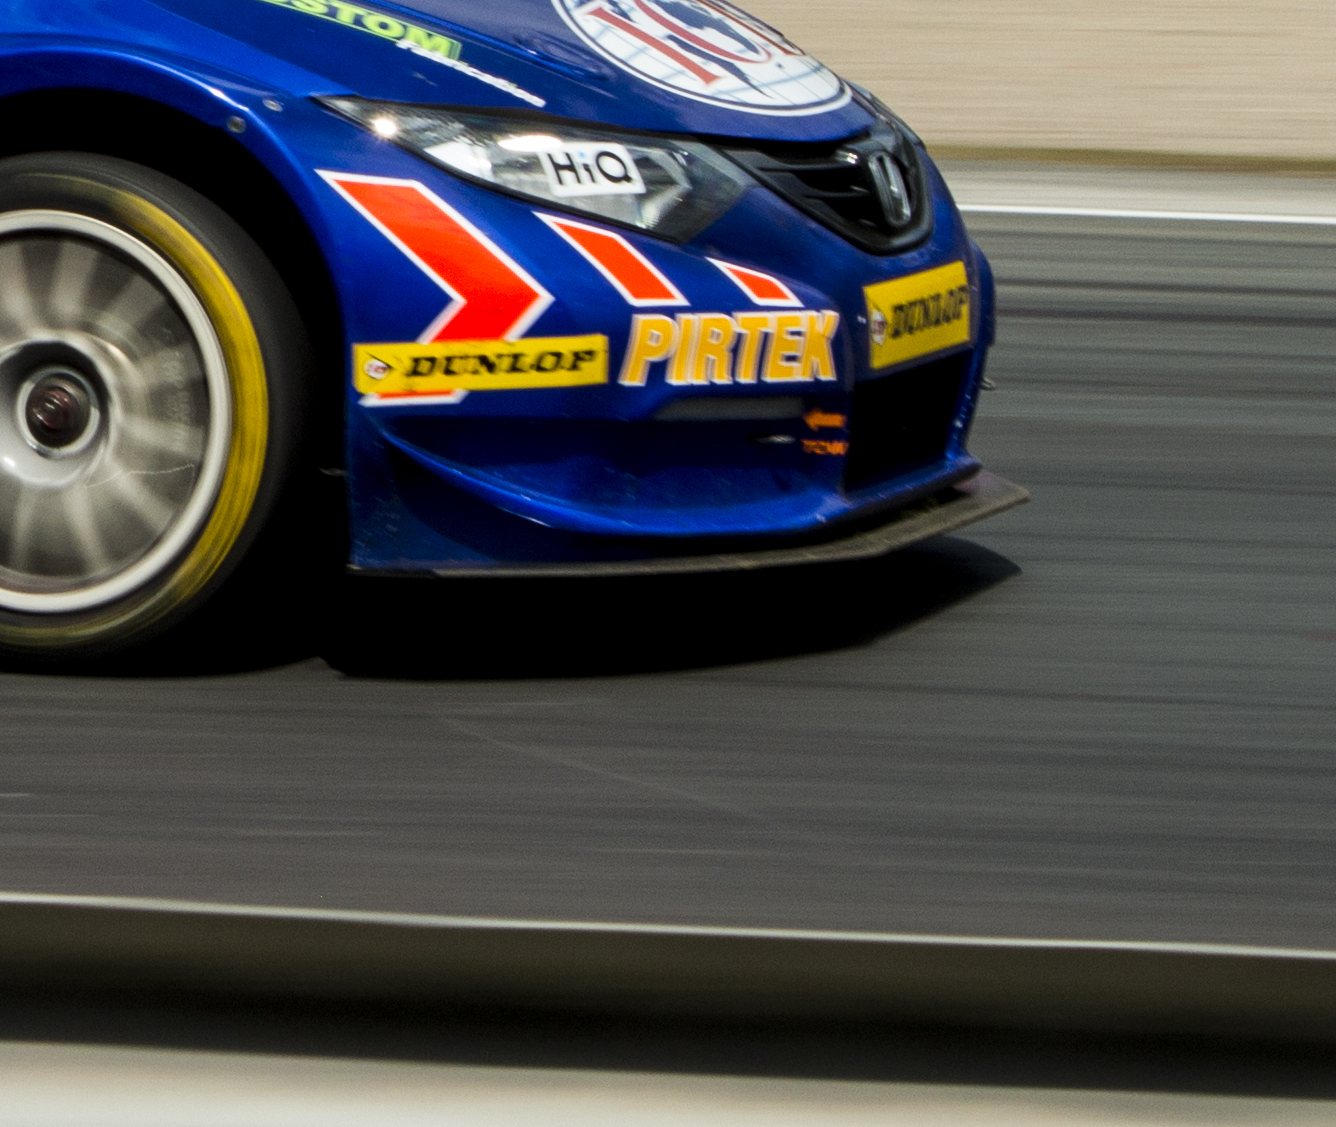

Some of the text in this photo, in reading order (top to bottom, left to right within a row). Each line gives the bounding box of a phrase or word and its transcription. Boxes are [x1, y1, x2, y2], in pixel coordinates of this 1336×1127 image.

[547, 151, 633, 185] HiQ
[889, 283, 968, 339] DUNLOP
[404, 349, 599, 378] DUNLOP
[617, 310, 840, 387] PIRTEK
